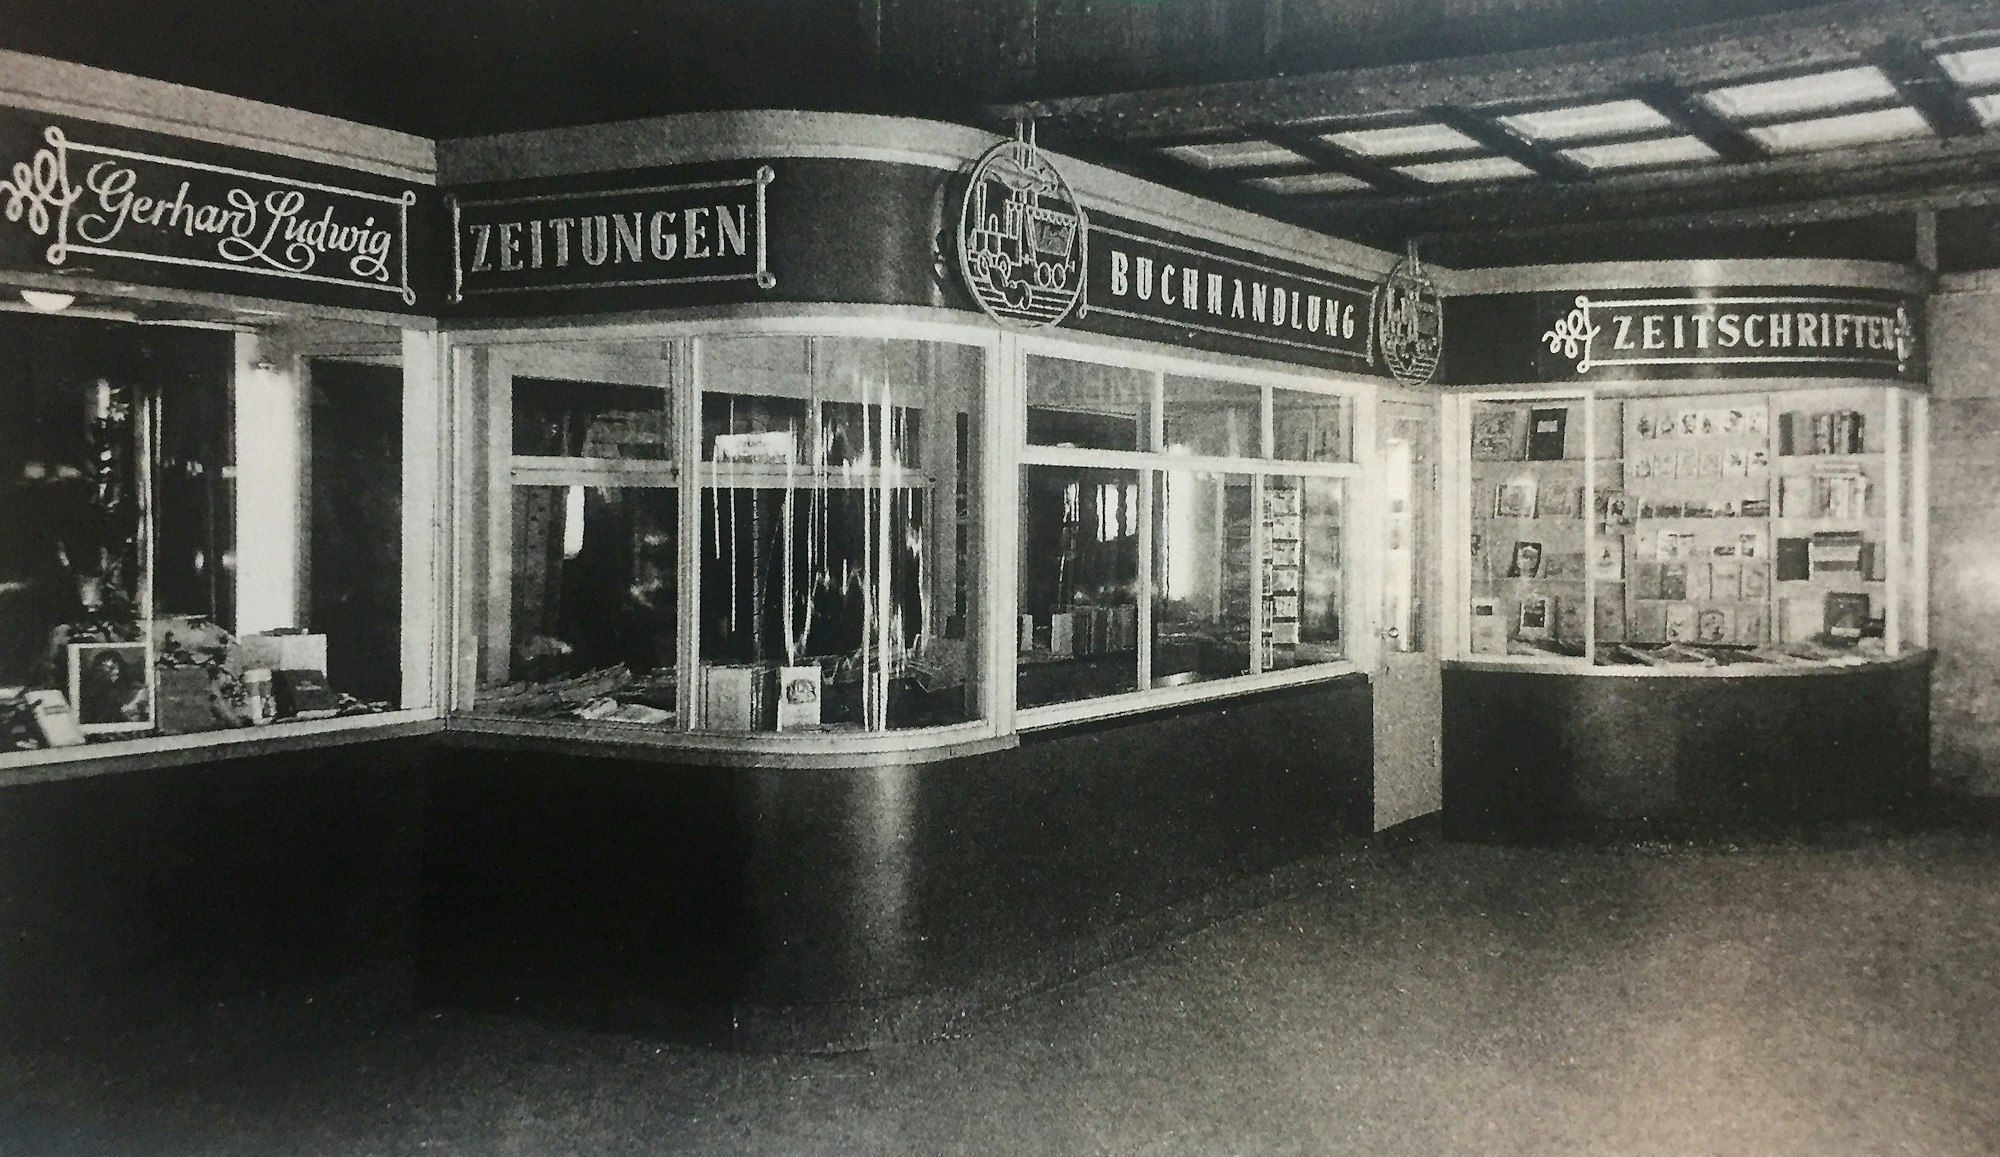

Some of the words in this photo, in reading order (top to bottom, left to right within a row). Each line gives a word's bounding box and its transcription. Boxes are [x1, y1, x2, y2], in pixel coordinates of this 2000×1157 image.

[76, 160, 259, 243] Gerhard
[217, 190, 392, 282] Ludwig
[469, 204, 747, 272] ZEITUNGEN
[1110, 250, 1355, 340] BUCHHANDLUNG
[1612, 312, 1895, 351] ZEITSCHRIFTEN
